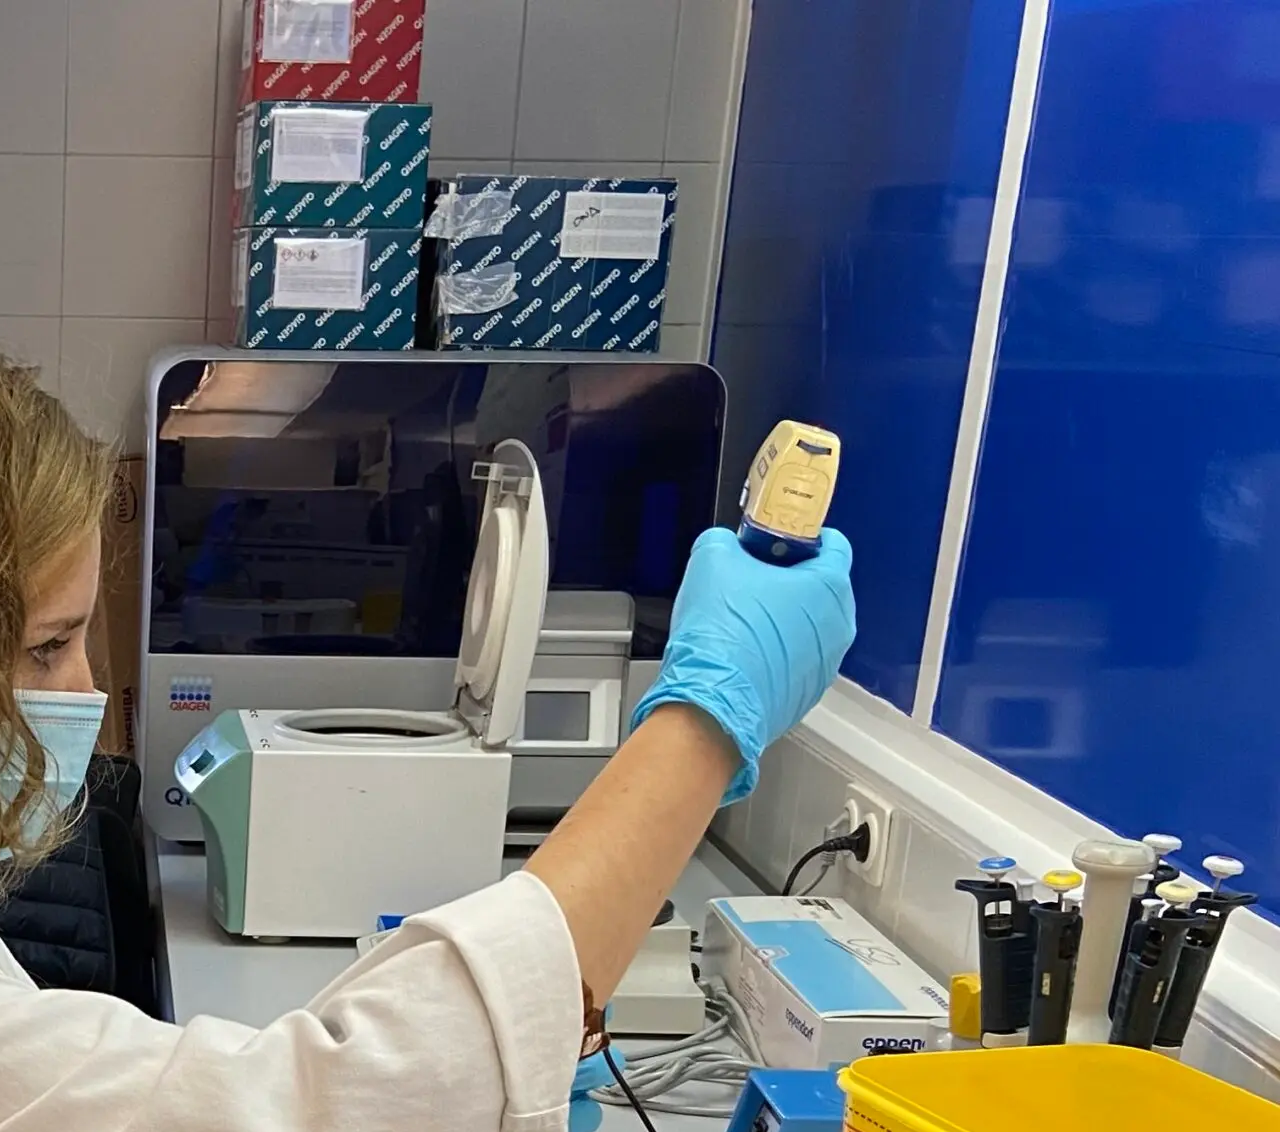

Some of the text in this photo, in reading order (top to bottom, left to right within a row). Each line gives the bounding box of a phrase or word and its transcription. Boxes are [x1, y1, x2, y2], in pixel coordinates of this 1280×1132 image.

[376, 14, 405, 44] QIAGEN
[321, 70, 350, 100] QIAGEN
[359, 56, 388, 85] QIAGEN
[379, 119, 410, 151] QIAGEN
[362, 161, 391, 192] QIAGEN
[400, 146, 430, 177] QIAGEN
[285, 192, 315, 222] QIAGEN
[382, 188, 413, 218] QIAGEN
[530, 190, 561, 220] QIAGEN
[369, 241, 399, 272] QIAGEN
[471, 245, 502, 275] QIAGEN
[511, 231, 542, 261] QIAGEN
[390, 267, 419, 297] QIAGEN
[531, 257, 562, 287] QIAGEN
[590, 269, 620, 299] QIAGEN
[511, 298, 542, 328] QIAGEN
[551, 283, 582, 313] QIAGEN
[610, 294, 639, 324] QIAGEN
[277, 312, 306, 342] QIAGEN
[373, 307, 403, 338] QIAGEN
[472, 311, 503, 341] QIAGEN
[572, 309, 602, 338] QIAGEN
[628, 320, 659, 349] QIAGEN
[170, 701, 211, 712] QIAGEN
[862, 1036, 925, 1052] eppen
